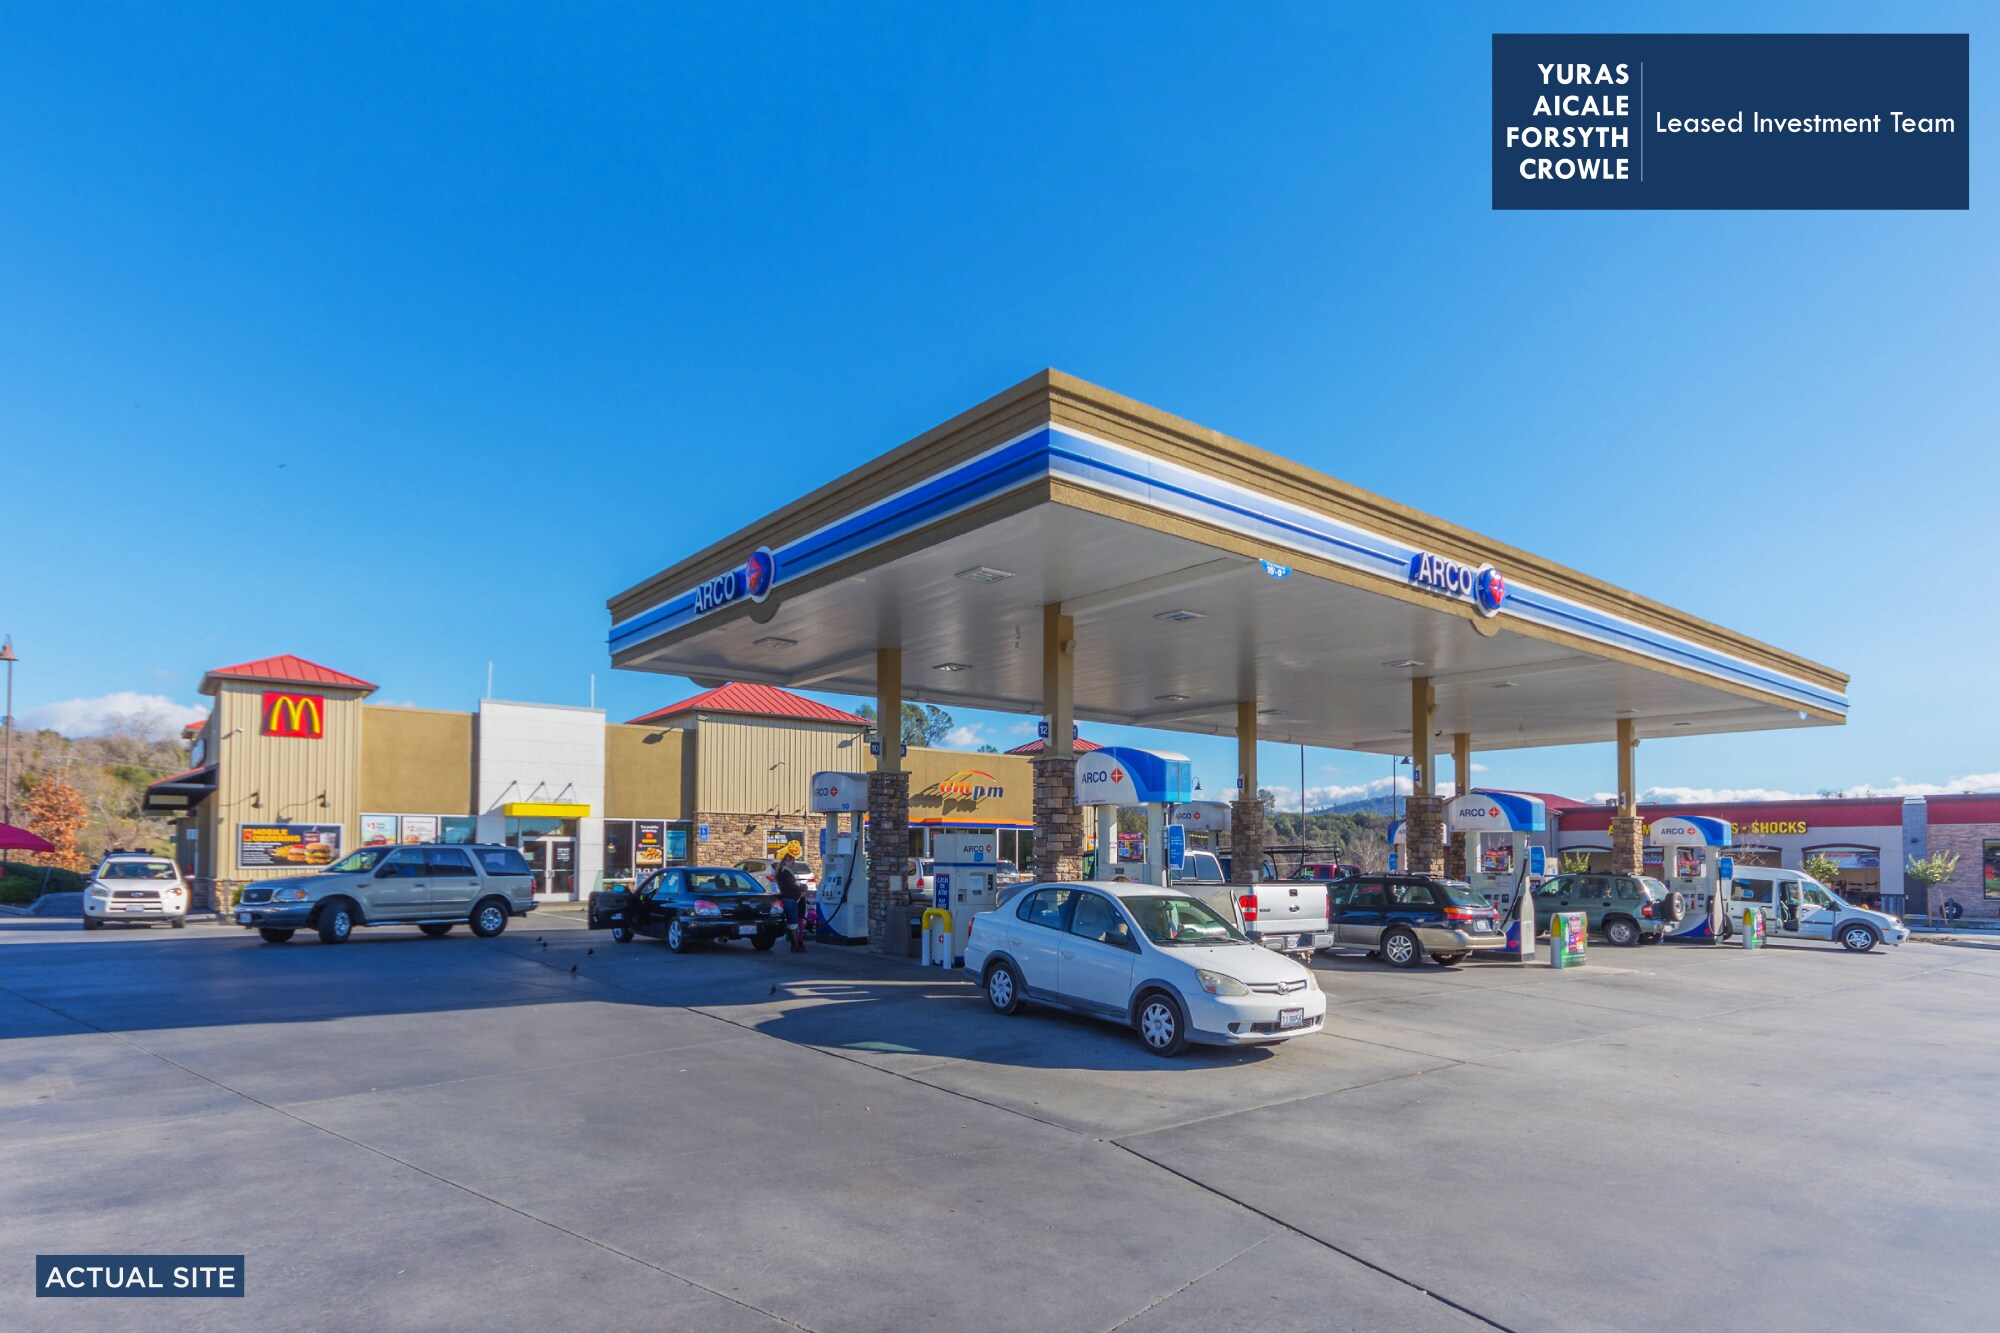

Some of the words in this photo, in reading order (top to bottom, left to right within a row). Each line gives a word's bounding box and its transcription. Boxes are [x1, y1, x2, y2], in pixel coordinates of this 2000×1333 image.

[1418, 551, 1473, 596] ARCO
[693, 571, 735, 614] ARCO
[1039, 724, 1049, 736] 12
[872, 744, 880, 754] 10
[1081, 770, 1108, 784] ARCO
[1175, 811, 1192, 820] ARCO
[1459, 808, 1486, 817] ARCO
[1661, 827, 1685, 836] ARCO
[1754, 821, 1808, 835] SHOCKS
[963, 845, 984, 853] ARCO
[937, 876, 949, 884] CASH
